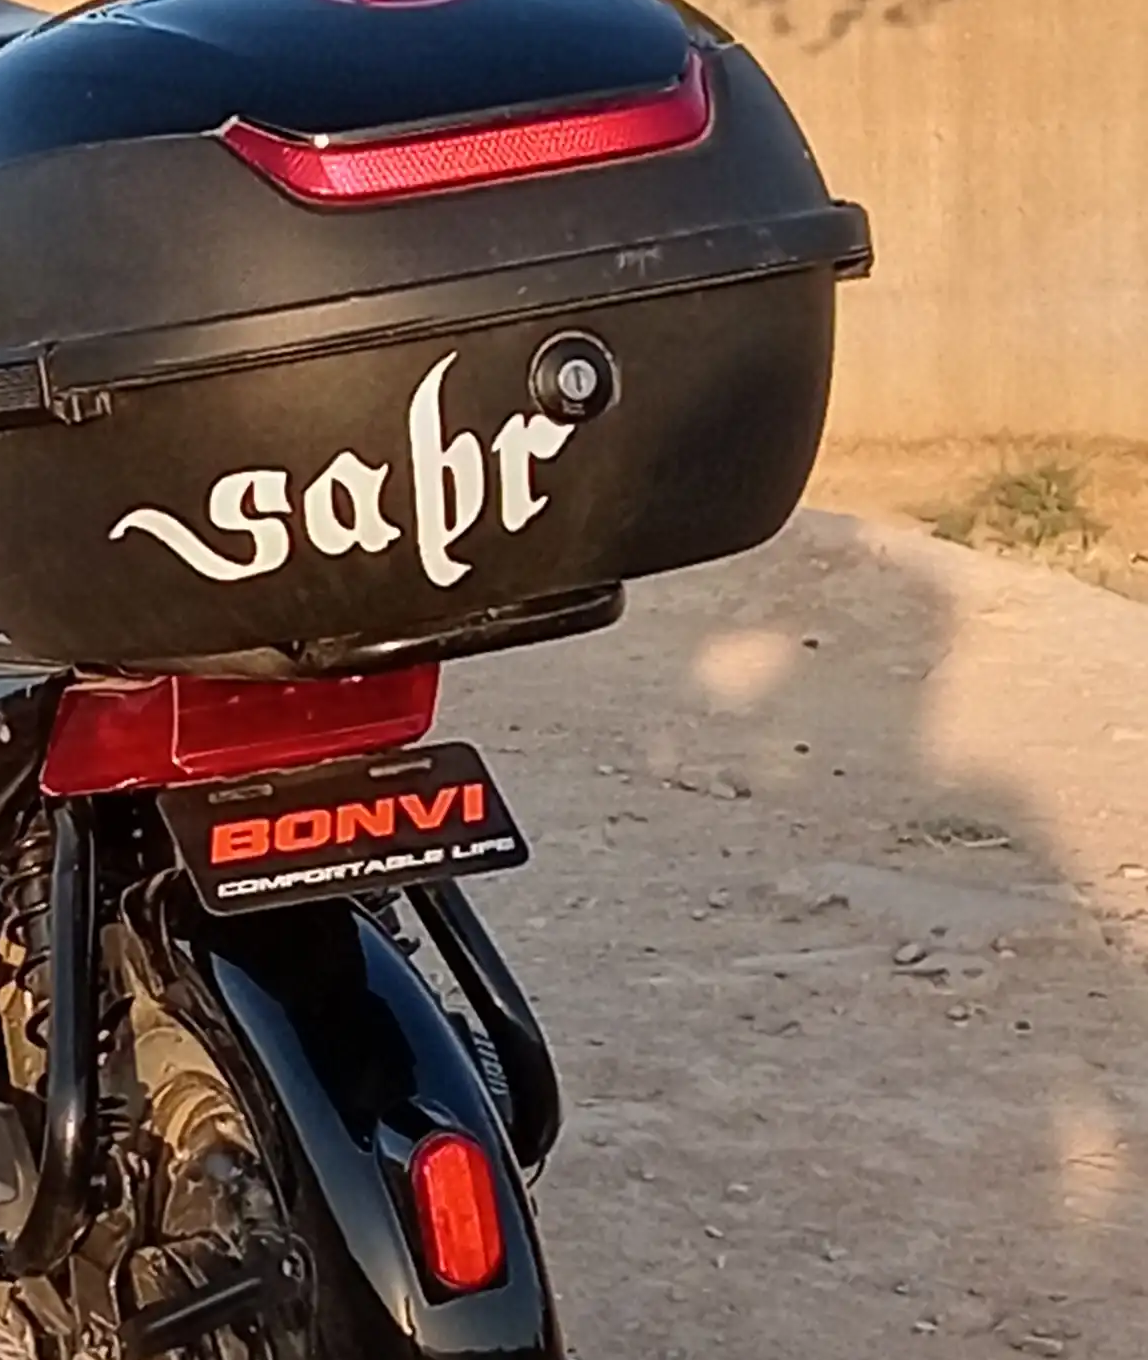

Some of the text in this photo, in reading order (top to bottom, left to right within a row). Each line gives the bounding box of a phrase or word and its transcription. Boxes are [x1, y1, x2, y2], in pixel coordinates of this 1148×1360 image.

[210, 783, 484, 864] BONVI
[217, 836, 516, 898] COMFORTABLE LIFE
